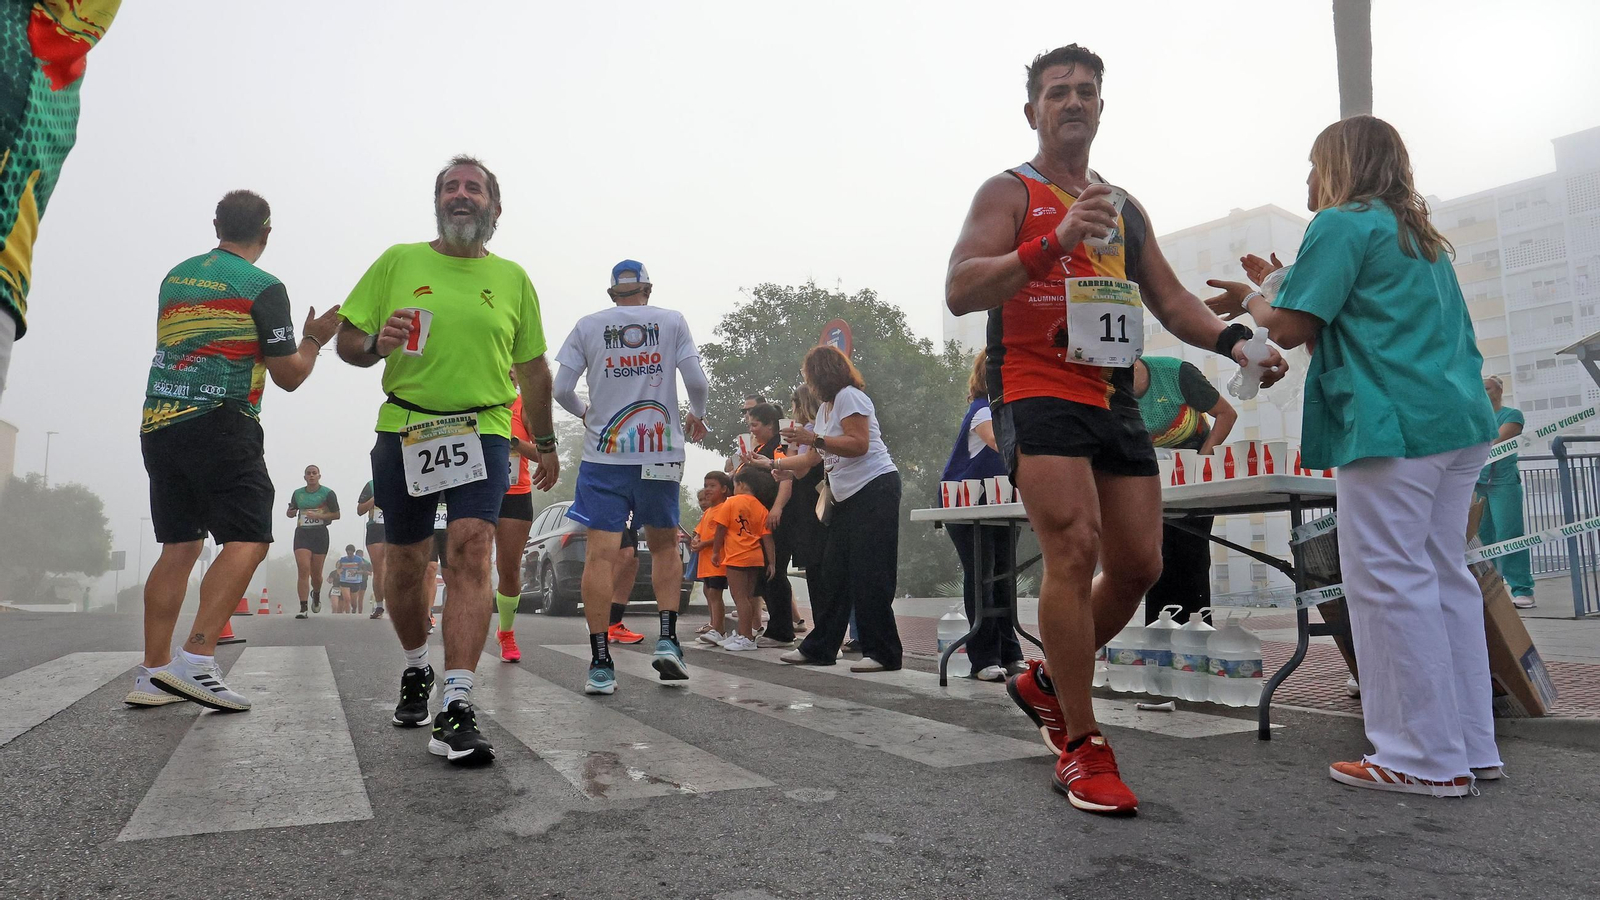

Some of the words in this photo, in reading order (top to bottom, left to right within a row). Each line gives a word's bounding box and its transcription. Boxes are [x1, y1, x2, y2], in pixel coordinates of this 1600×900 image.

[167, 276, 197, 286] PILAR
[196, 279, 227, 291] 2025
[1099, 312, 1130, 343] 11
[605, 356, 614, 368] 1
[619, 351, 661, 367] NIÑO
[604, 367, 609, 378] 1
[613, 364, 663, 378] SONRISA
[1558, 407, 1596, 429] GUARDIA
[406, 421, 434, 432] CARRERA
[1534, 423, 1557, 438] CIVIL
[418, 442, 469, 474] 245
[1313, 517, 1336, 531] CIVIL
[1560, 523, 1584, 536] CIVIL
[1503, 535, 1543, 552] GUARDIA
[1479, 546, 1502, 559] CIVIL
[1319, 587, 1342, 599] CIVIL
